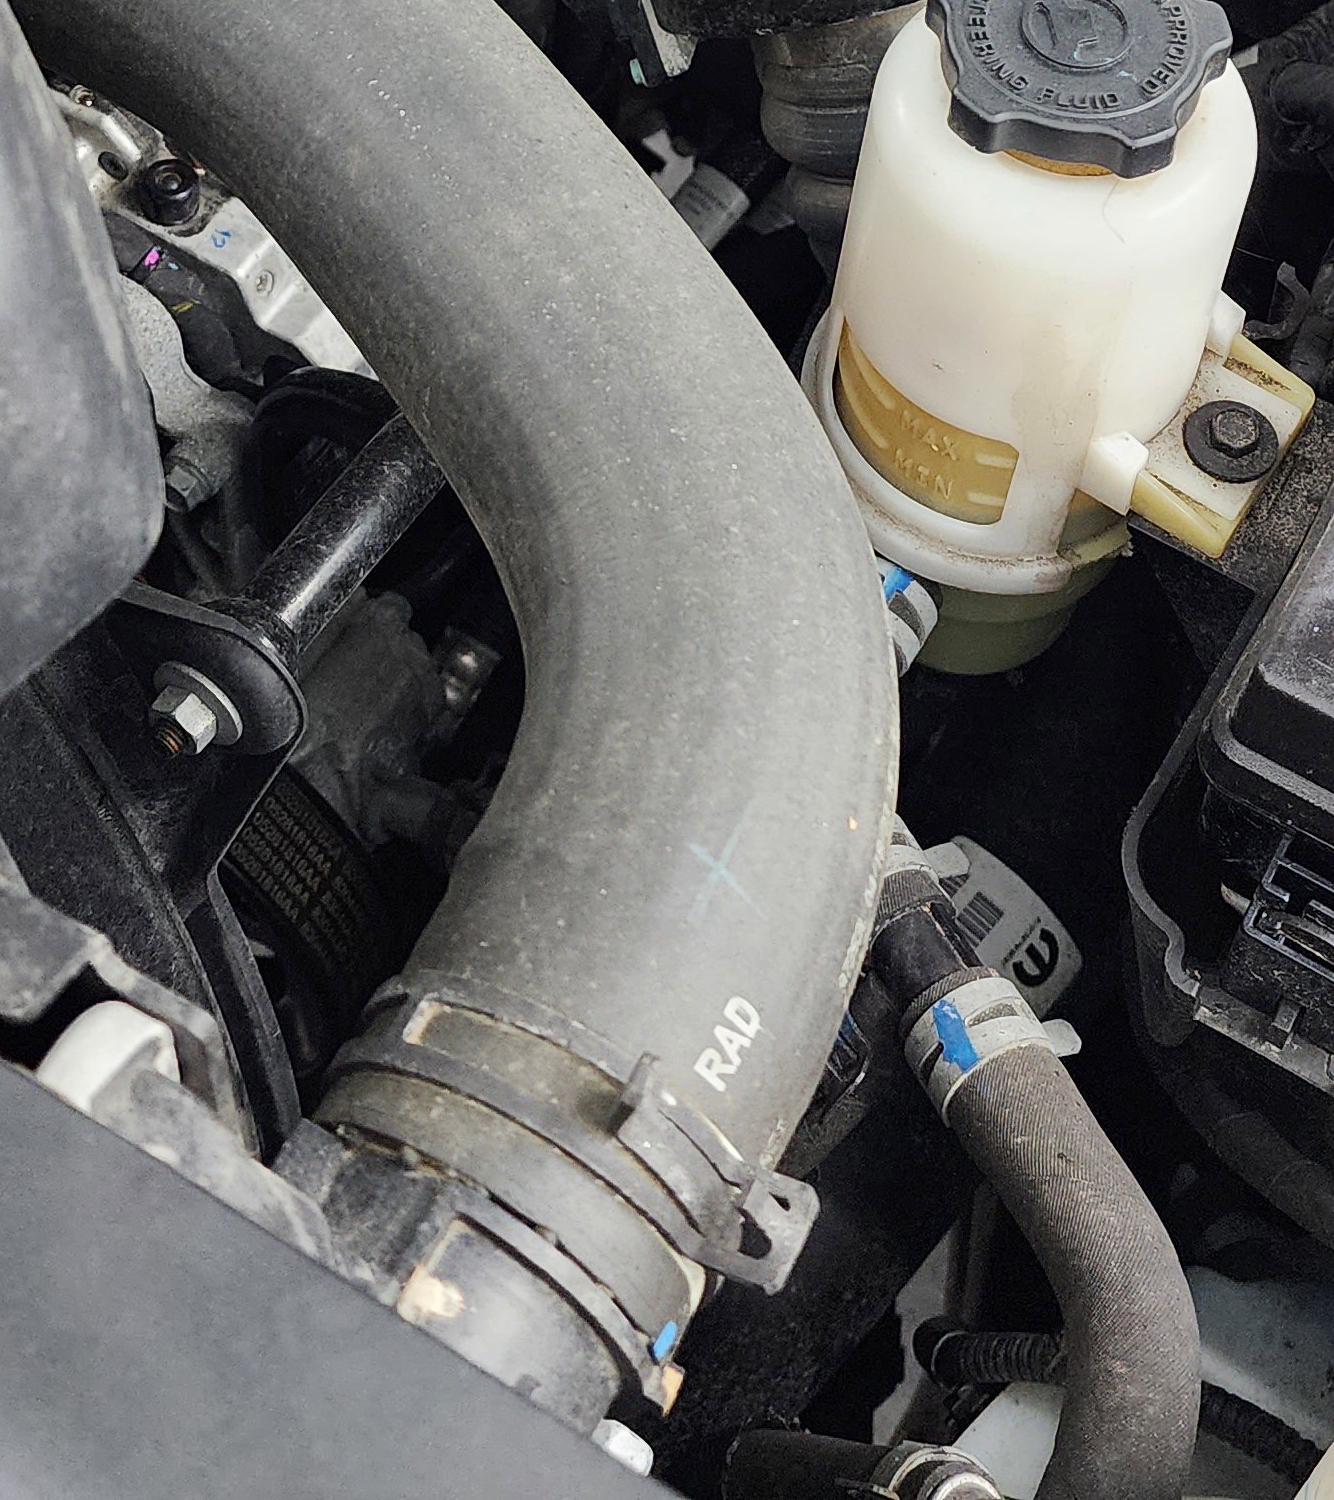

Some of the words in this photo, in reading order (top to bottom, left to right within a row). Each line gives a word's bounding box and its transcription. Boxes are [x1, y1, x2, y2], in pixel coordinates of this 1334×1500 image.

[1036, 87, 1120, 111] FLUID
[900, 409, 959, 461] MAX
[894, 448, 955, 500] MIN
[693, 996, 762, 1092] RAD
